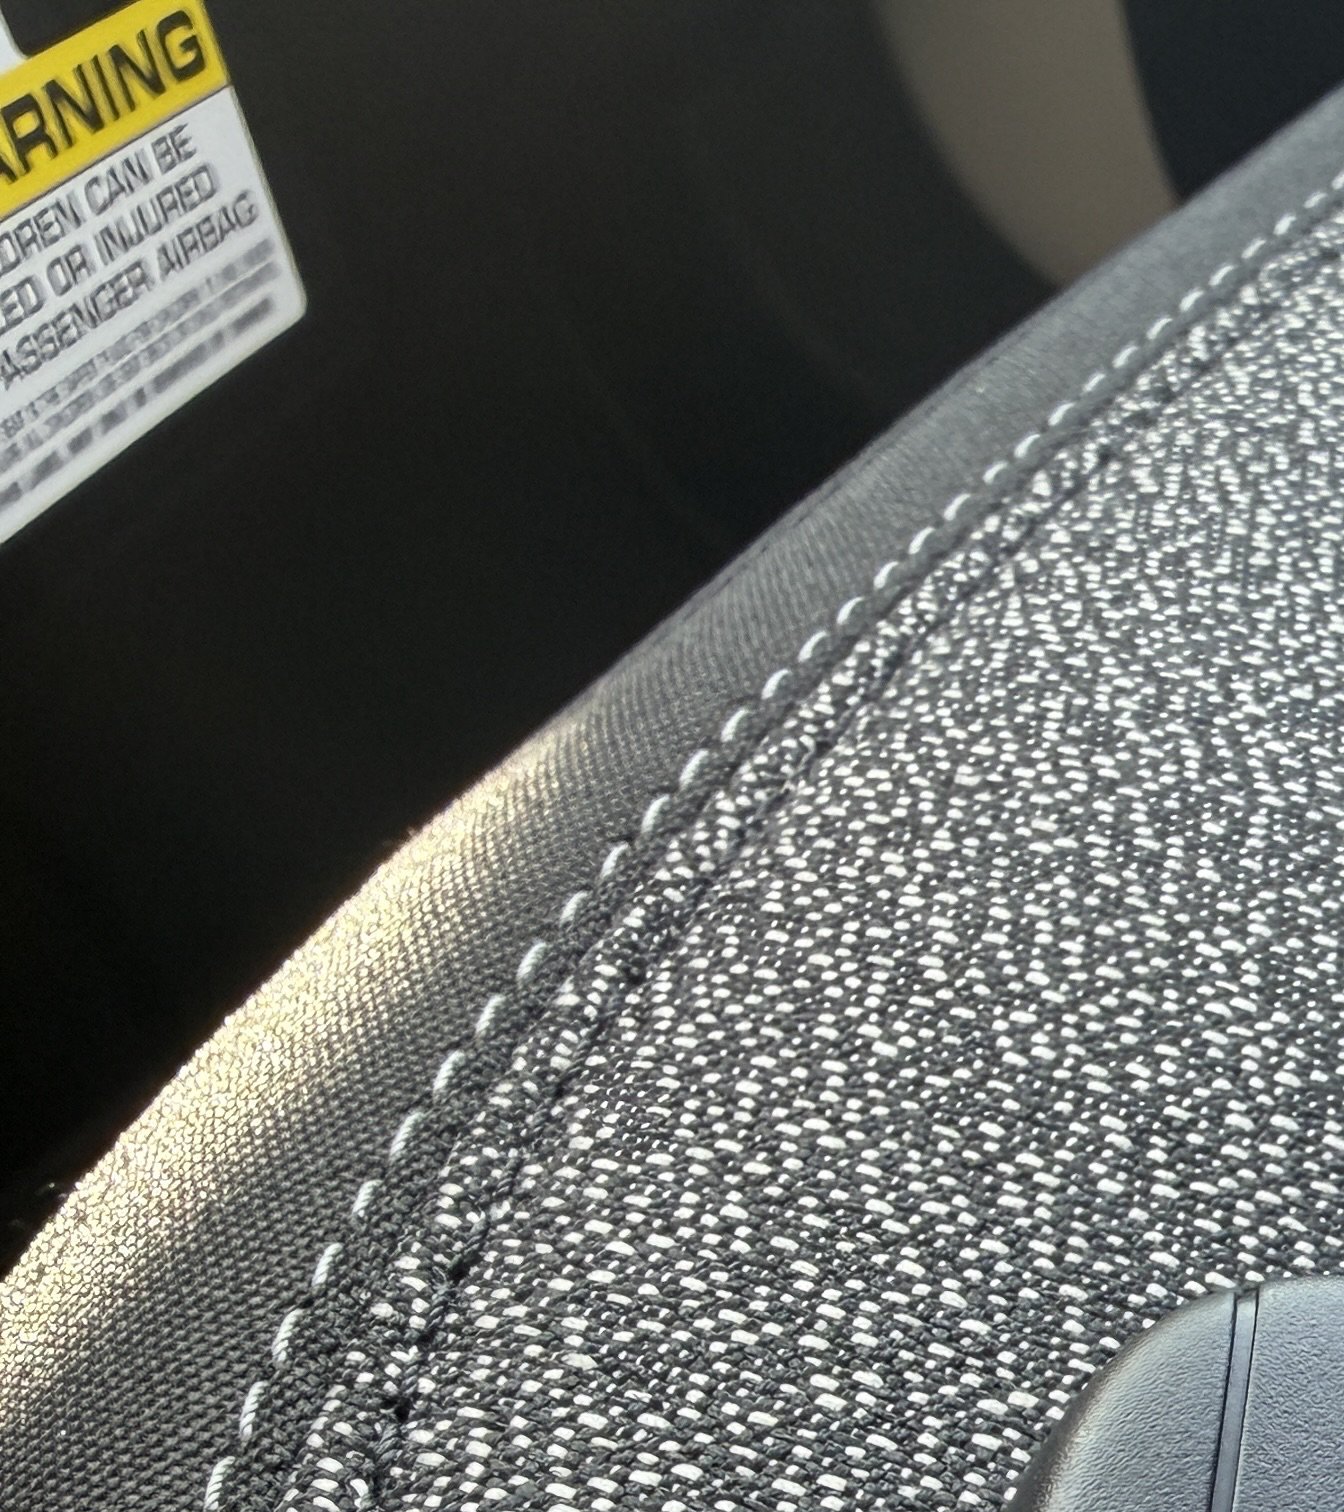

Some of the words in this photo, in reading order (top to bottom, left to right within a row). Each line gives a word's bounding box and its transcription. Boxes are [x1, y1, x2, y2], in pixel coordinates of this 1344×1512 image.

[0, 9, 206, 186] RNING
[84, 148, 152, 216] CAN
[151, 122, 197, 175] BE
[157, 190, 258, 280] AIRBAG
[0, 275, 46, 334] ED
[47, 244, 95, 297] OR
[95, 163, 218, 267] INJURED
